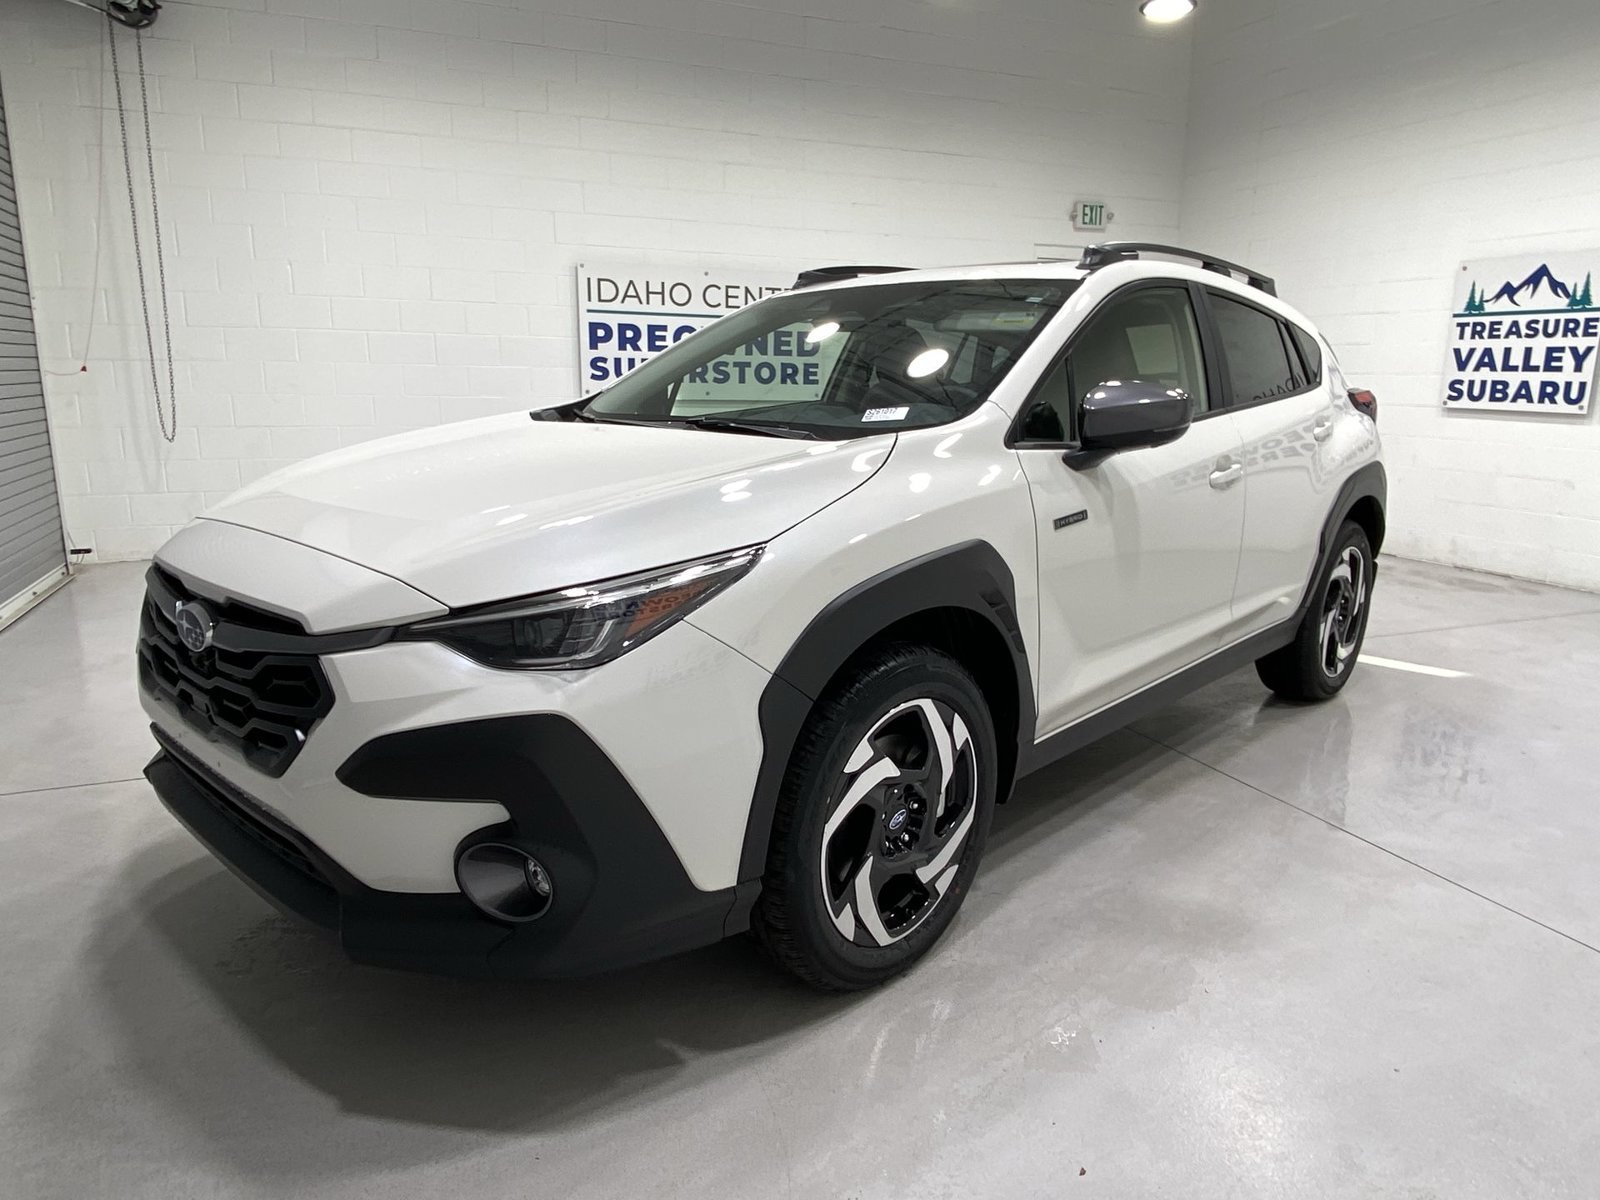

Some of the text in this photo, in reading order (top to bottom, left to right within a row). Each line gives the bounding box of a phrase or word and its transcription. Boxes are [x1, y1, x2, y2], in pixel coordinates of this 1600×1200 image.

[1082, 204, 1104, 226] EXIT
[586, 277, 794, 309] IDAHO CENT
[1456, 317, 1600, 341] TREASURE
[589, 356, 819, 385] SURSTORE
[1453, 346, 1595, 373] VALLEY
[1447, 378, 1587, 406] SUBARU
